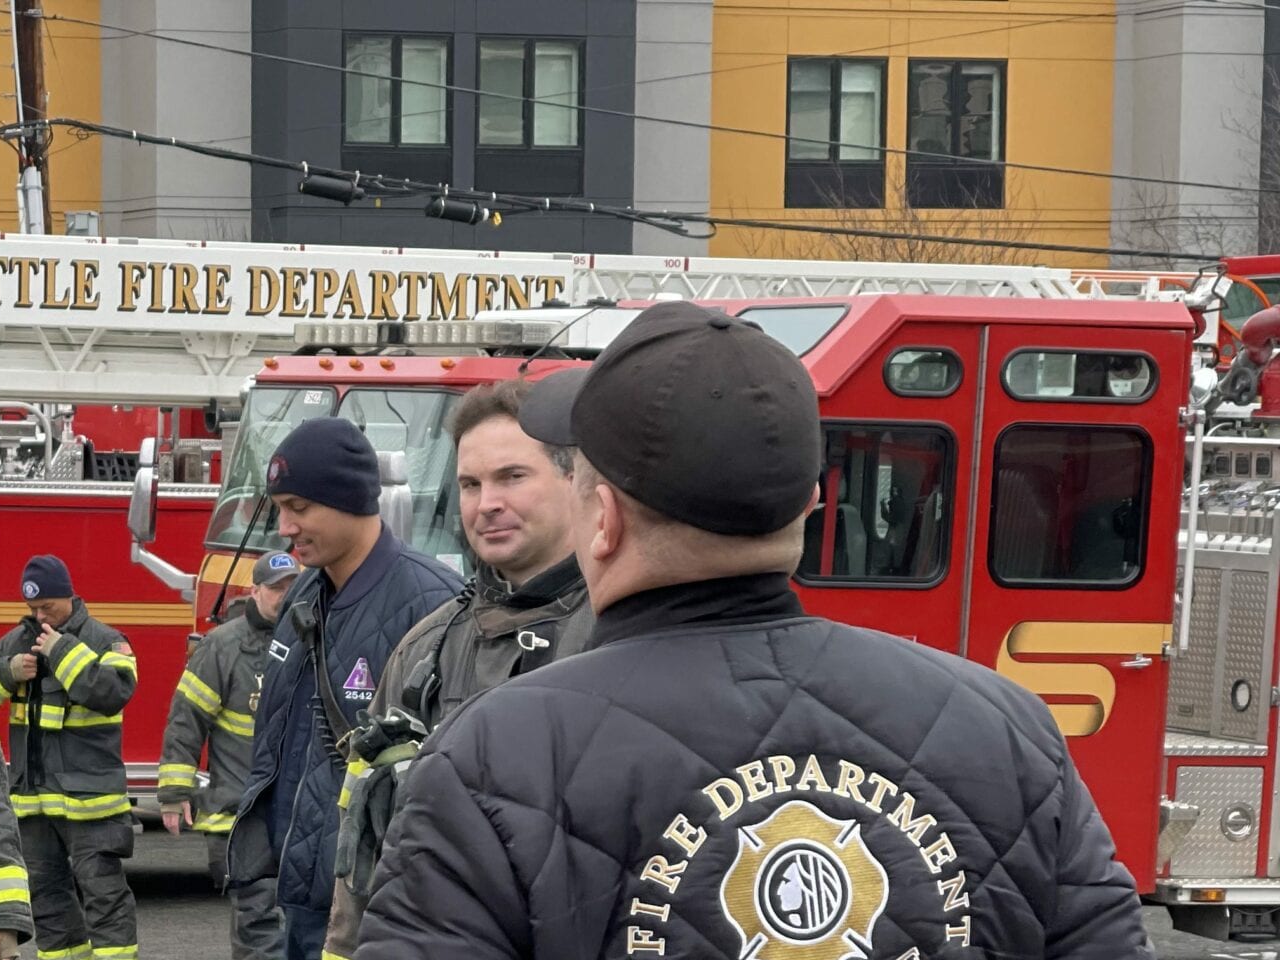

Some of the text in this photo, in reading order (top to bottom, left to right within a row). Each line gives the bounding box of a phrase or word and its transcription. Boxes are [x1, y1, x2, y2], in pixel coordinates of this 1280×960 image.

[573, 255, 586, 265] 95
[663, 259, 681, 268] 100
[117, 261, 231, 314] FIRE
[246, 266, 565, 320] DEPARTMENT
[344, 690, 373, 700] 2542
[627, 754, 971, 955] FIRE DEPARTMENT
